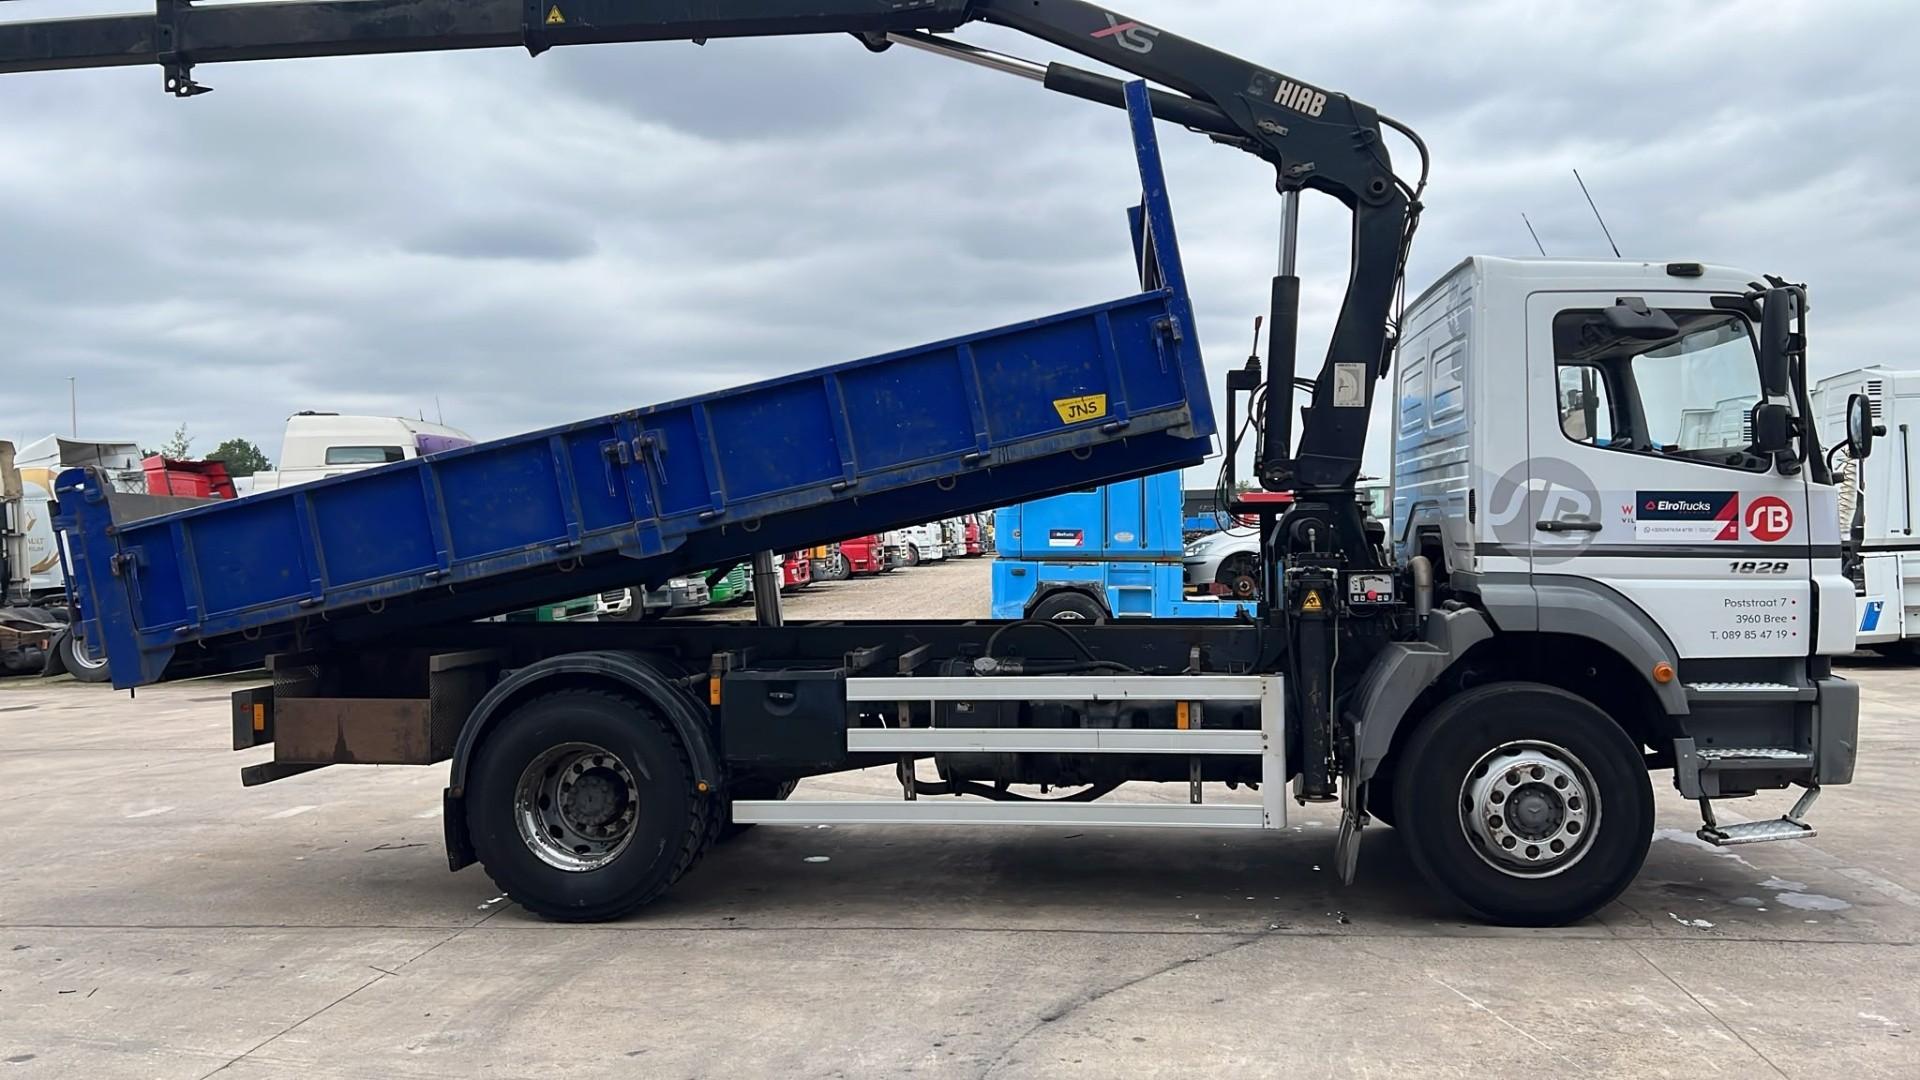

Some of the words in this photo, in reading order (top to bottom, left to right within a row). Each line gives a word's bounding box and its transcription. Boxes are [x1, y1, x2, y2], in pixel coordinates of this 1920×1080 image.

[1090, 13, 1160, 53] XS
[1274, 79, 1327, 118] HIAB
[1068, 401, 1097, 418] JNS
[1729, 561, 1789, 574] 1828
[1724, 598, 1777, 608] Poststraat
[1780, 598, 1787, 607] 7
[1736, 614, 1761, 623] 3960
[1763, 614, 1788, 623] Bree
[1710, 630, 1719, 640] T.
[1721, 630, 1741, 640] 089
[1744, 630, 1757, 639] 85
[1759, 630, 1772, 639] 47
[1776, 630, 1788, 639] 19
